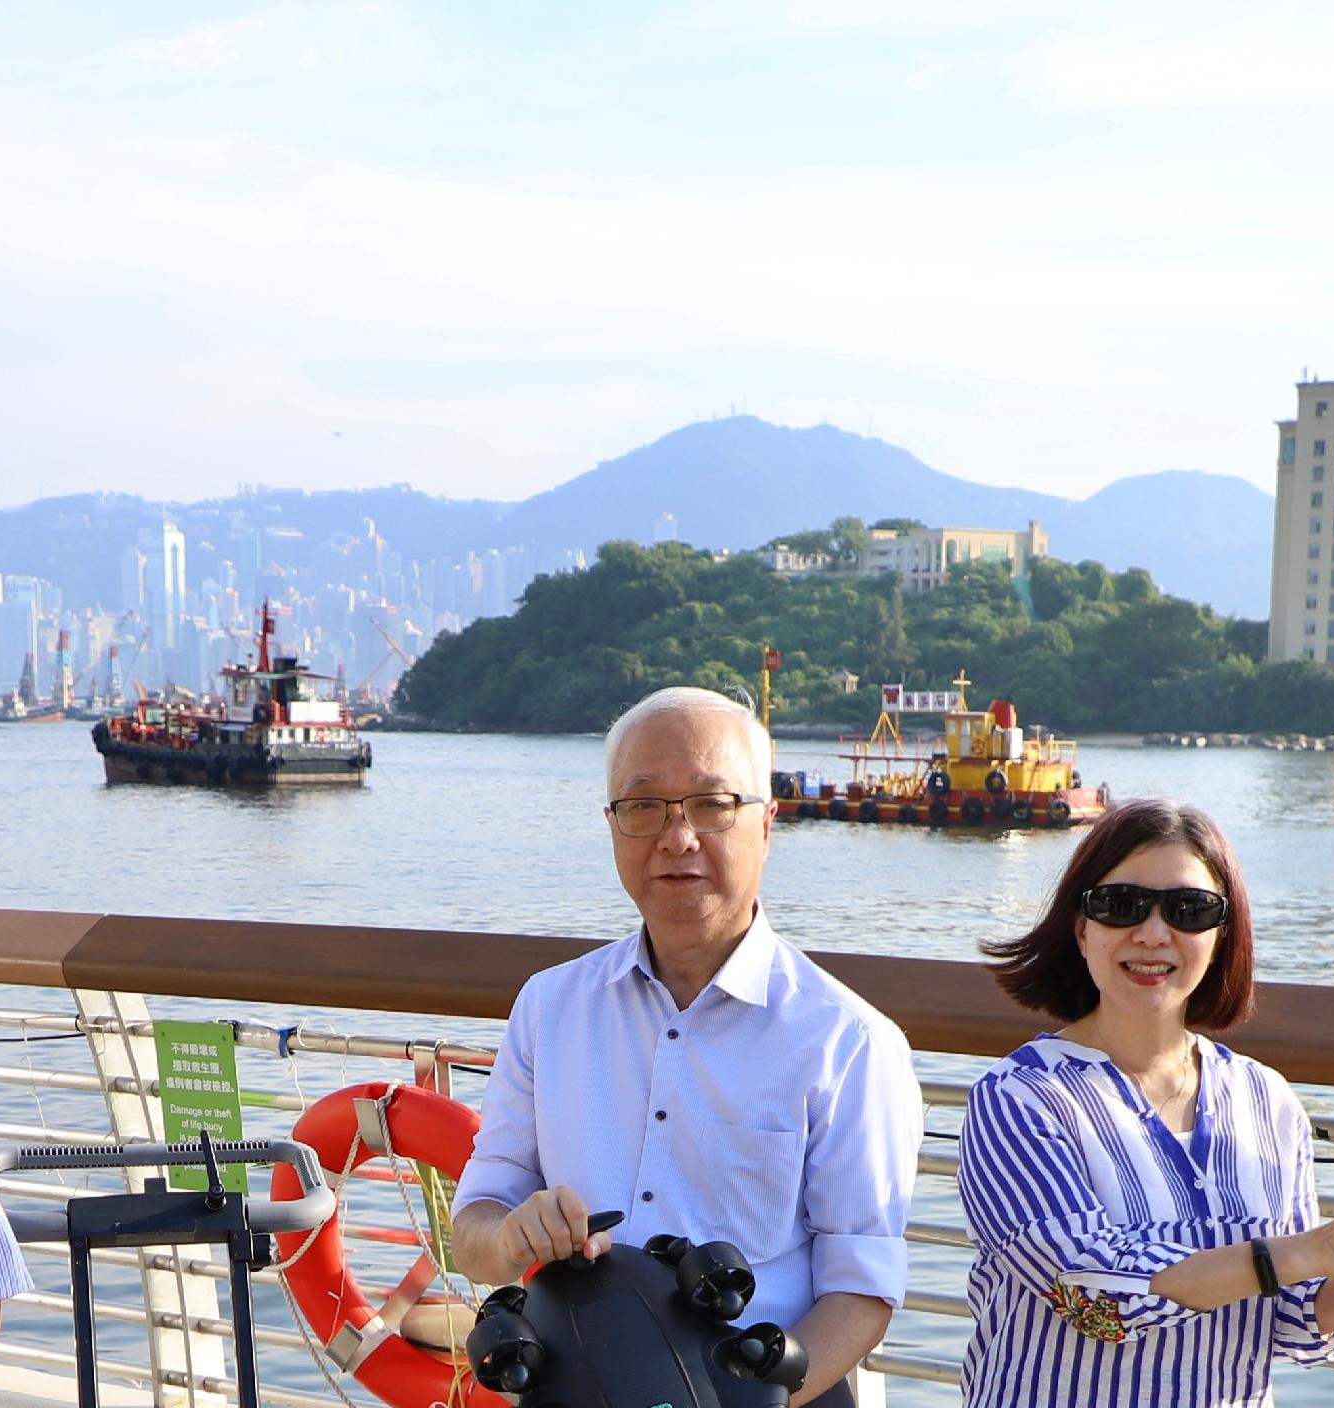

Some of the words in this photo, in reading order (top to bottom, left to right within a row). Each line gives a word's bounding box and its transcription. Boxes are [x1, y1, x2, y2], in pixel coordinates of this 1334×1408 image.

[170, 1103, 203, 1117] Damage
[204, 1108, 212, 1117] or
[214, 1108, 232, 1119] theft
[181, 1119, 189, 1129] of
[190, 1120, 203, 1130] life
[204, 1121, 223, 1134] buoy
[179, 1132, 186, 1141] is
